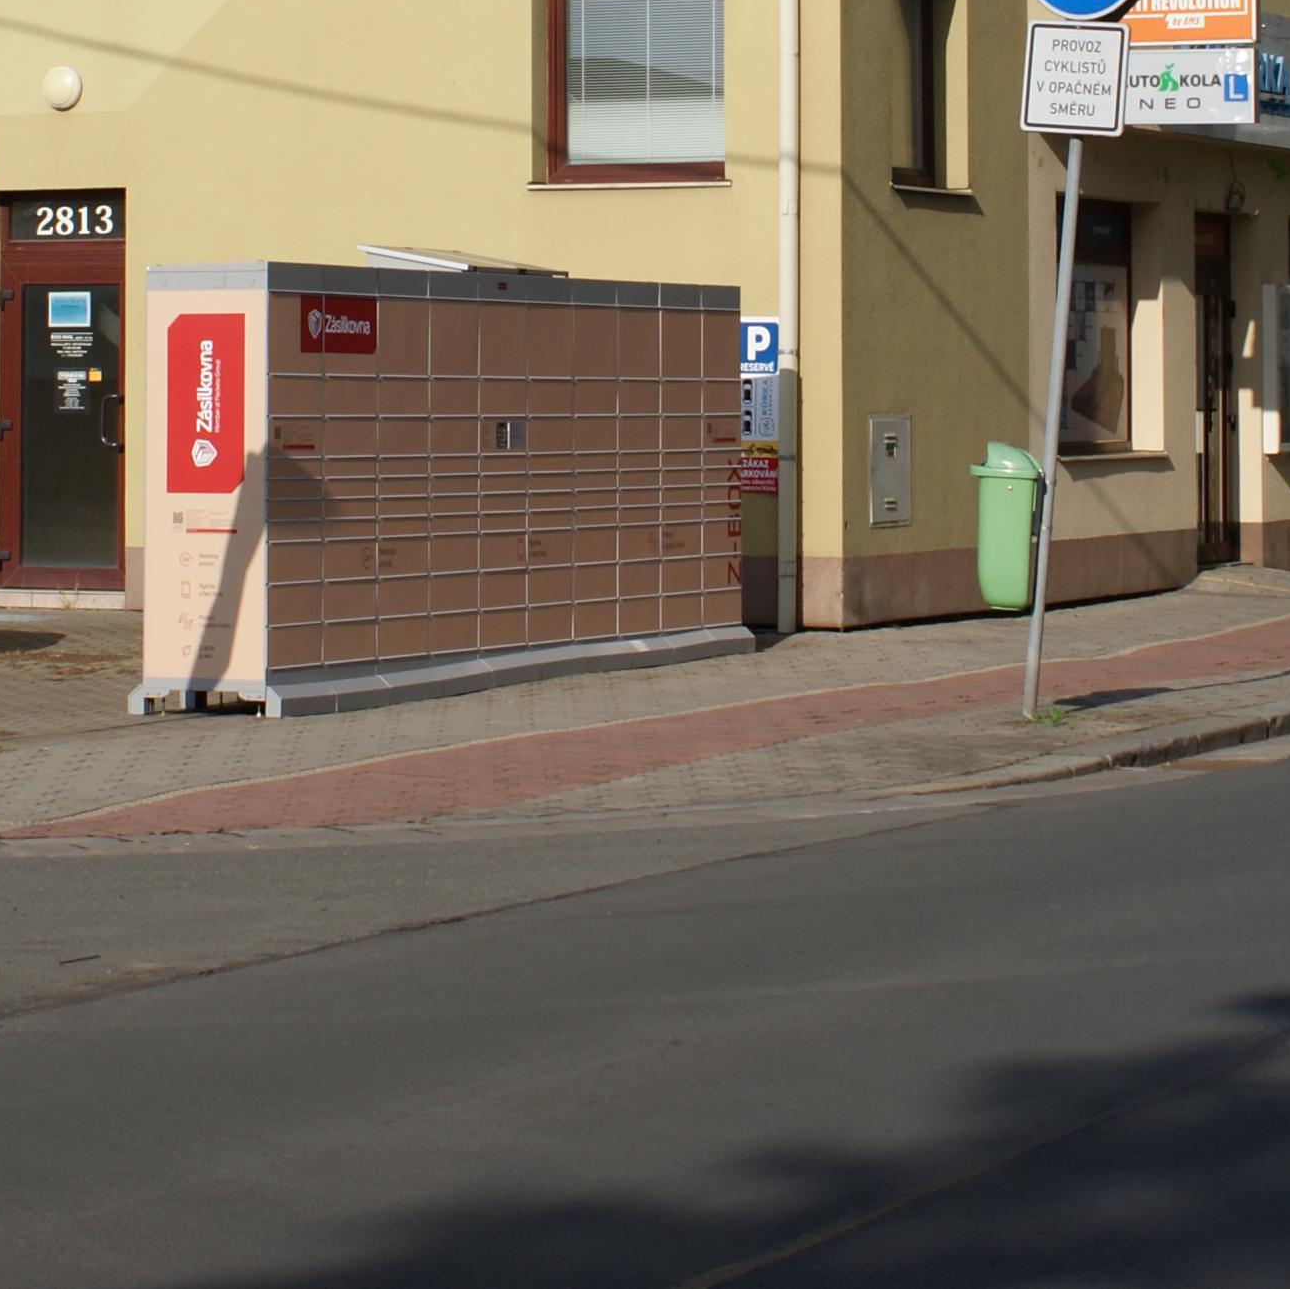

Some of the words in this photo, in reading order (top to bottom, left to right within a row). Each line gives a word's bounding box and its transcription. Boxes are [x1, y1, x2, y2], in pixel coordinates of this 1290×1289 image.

[1172, 16, 1182, 26] by
[1183, 15, 1201, 25] EMS
[1052, 39, 1102, 53] PROVOZ
[1044, 59, 1106, 74] CYKLISTŮ
[1126, 63, 1221, 91] UTOŠKOLA
[1036, 80, 1045, 92] V
[1049, 101, 1096, 116] SMĚRU
[1140, 97, 1201, 109] NEO
[36, 205, 113, 236] 2813
[325, 314, 371, 335] Zásilkovna
[747, 326, 771, 361] P
[196, 339, 213, 433] Zásilkovna
